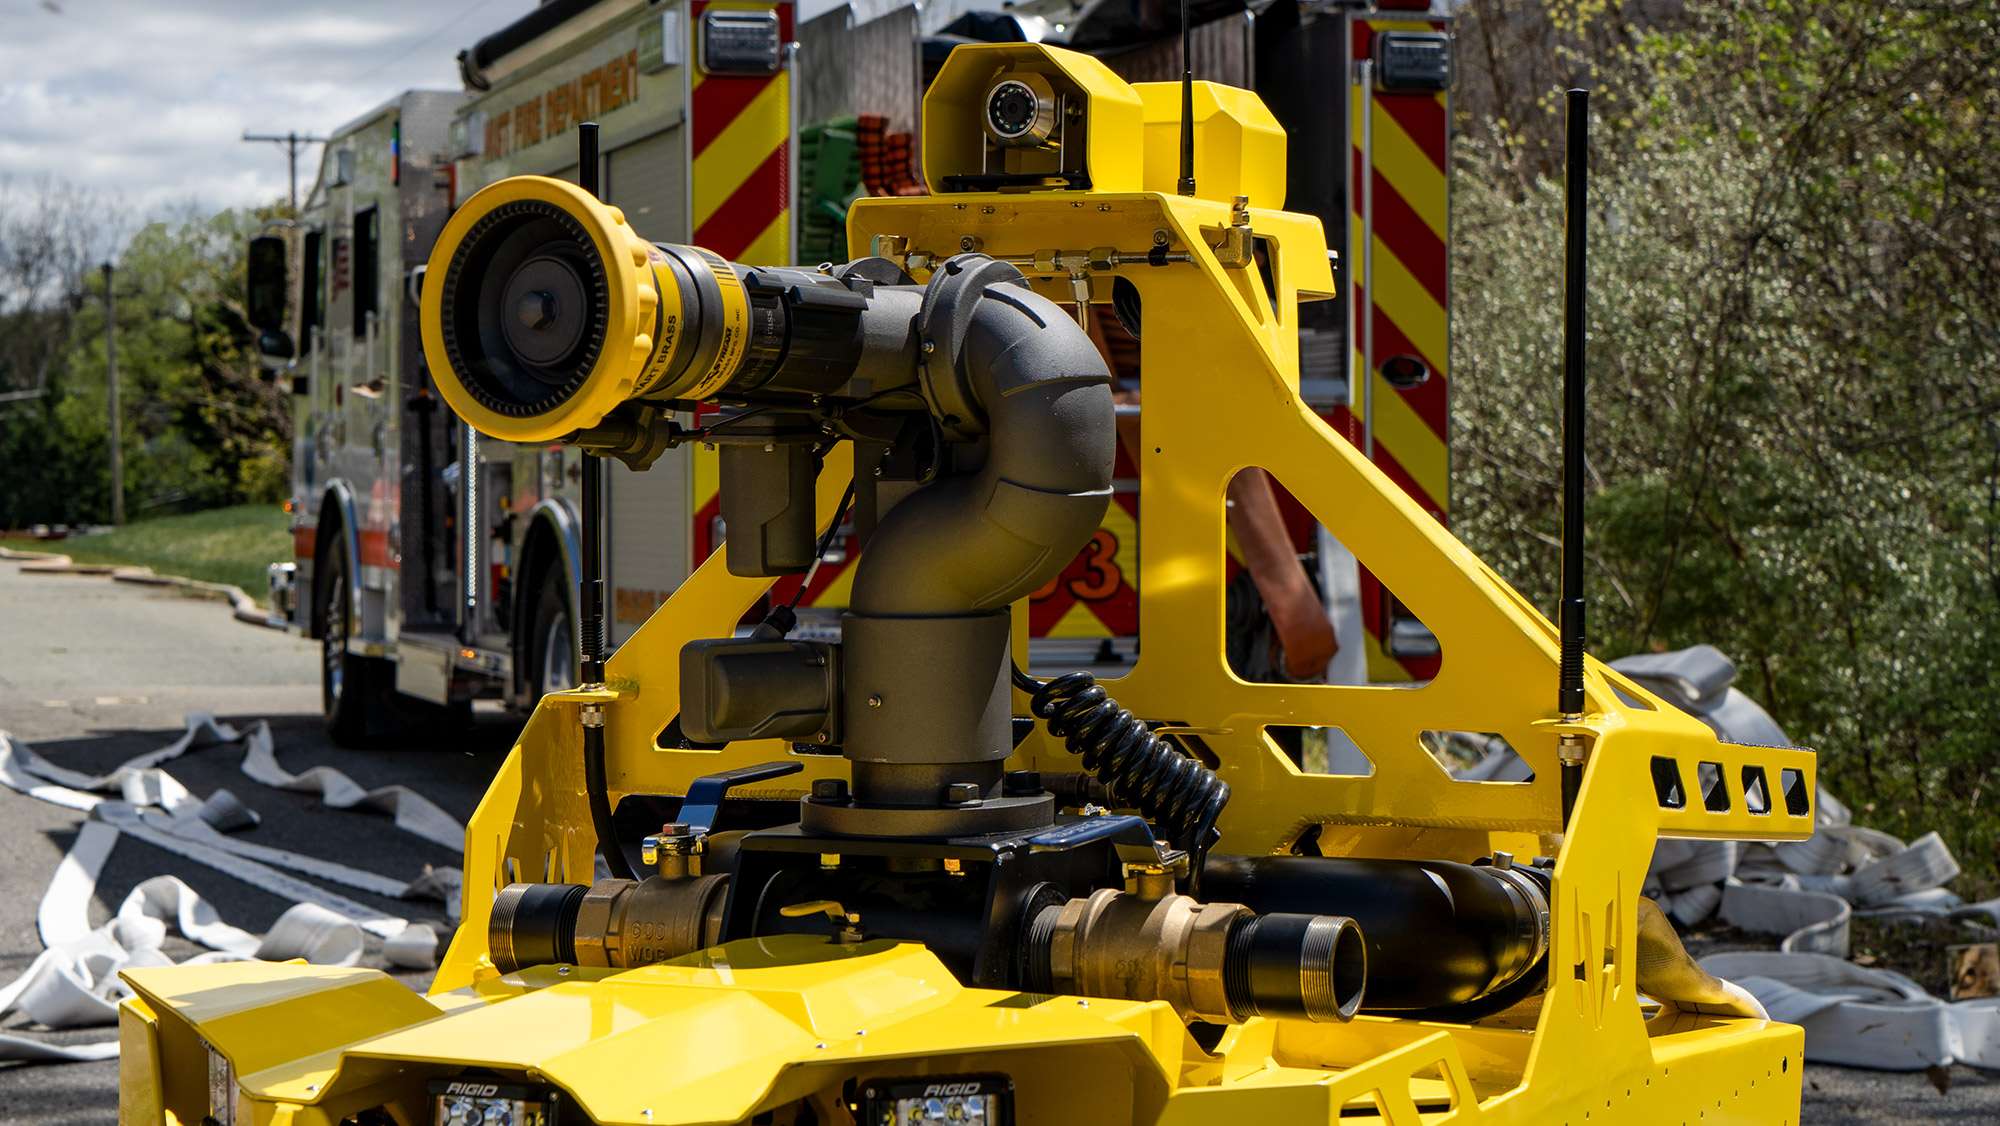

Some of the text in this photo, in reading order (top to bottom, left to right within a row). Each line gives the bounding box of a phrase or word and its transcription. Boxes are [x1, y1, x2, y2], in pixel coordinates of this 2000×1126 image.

[514, 95, 541, 152] FIRE
[545, 48, 639, 139] DEPARTMENT
[656, 314, 677, 363] BRASS
[631, 920, 665, 941] 600
[446, 1082, 499, 1097] RIGID
[923, 1081, 981, 1097] RIGID
